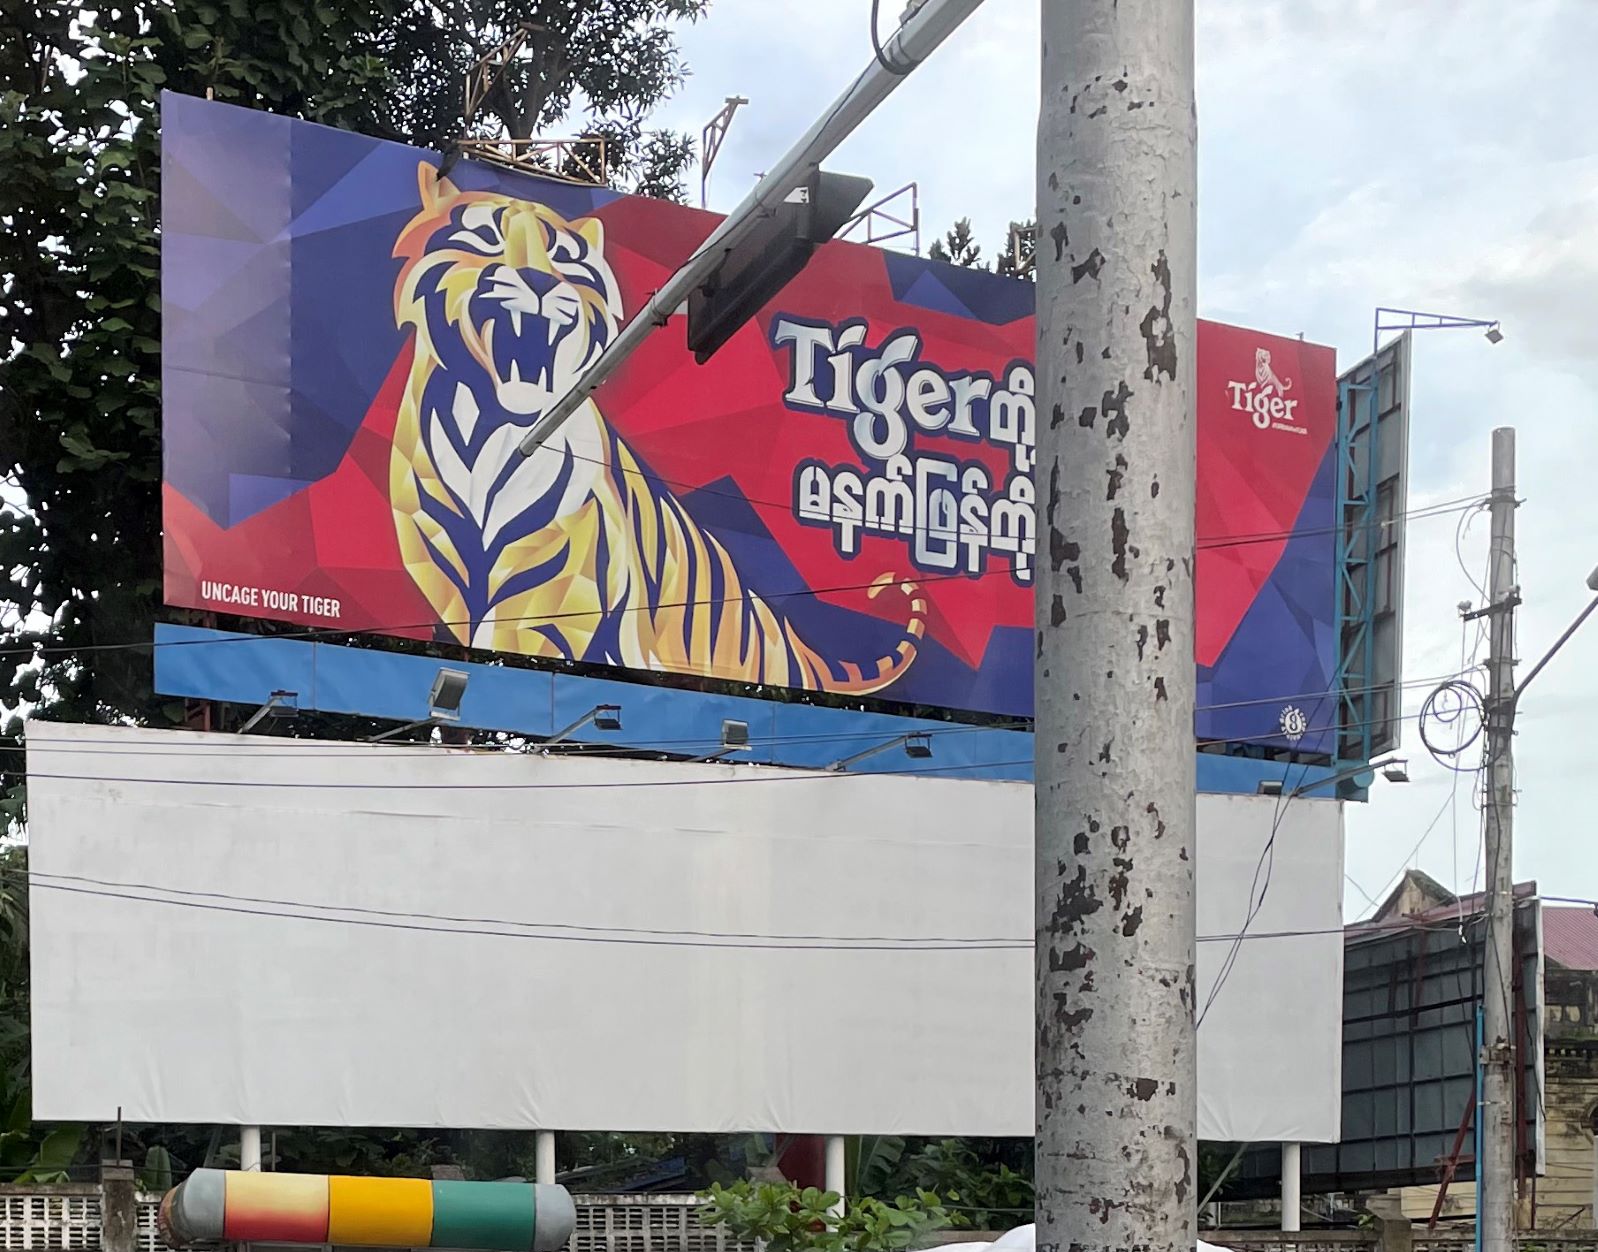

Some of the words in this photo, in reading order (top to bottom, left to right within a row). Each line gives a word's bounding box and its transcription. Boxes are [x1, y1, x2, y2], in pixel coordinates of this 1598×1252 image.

[1228, 380, 1298, 429] Tiger
[201, 580, 258, 606] UNCAGE
[261, 589, 298, 613] YOUR
[301, 595, 341, 618] TIGER
